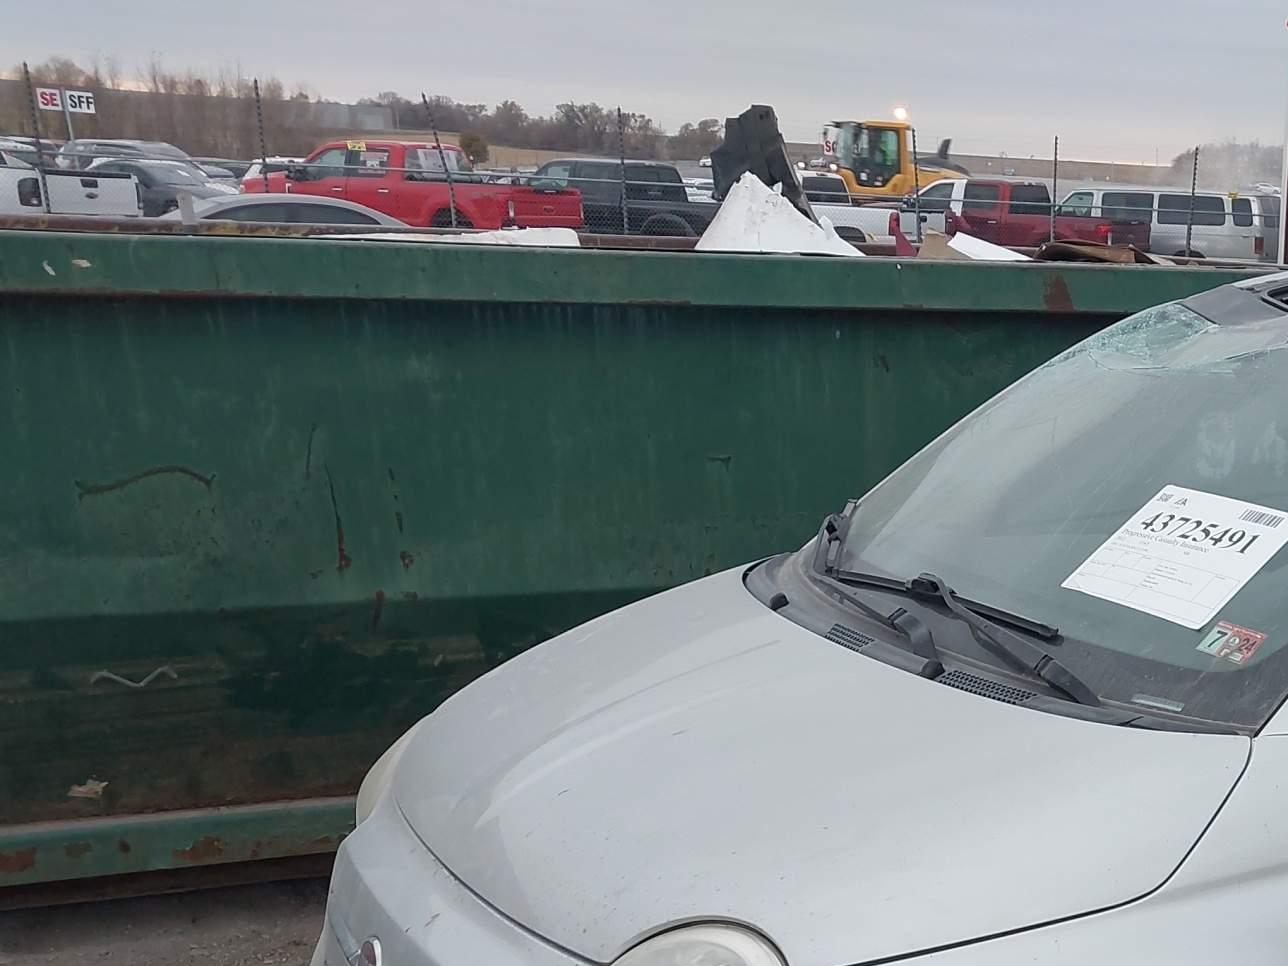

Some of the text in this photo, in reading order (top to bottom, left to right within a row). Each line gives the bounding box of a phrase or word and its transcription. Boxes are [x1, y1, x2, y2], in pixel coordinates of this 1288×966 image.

[40, 91, 60, 107] SE
[69, 94, 95, 110] SFF
[1141, 511, 1261, 554] 43725491
[1207, 630, 1228, 647] 7
[1239, 638, 1257, 654] 24
